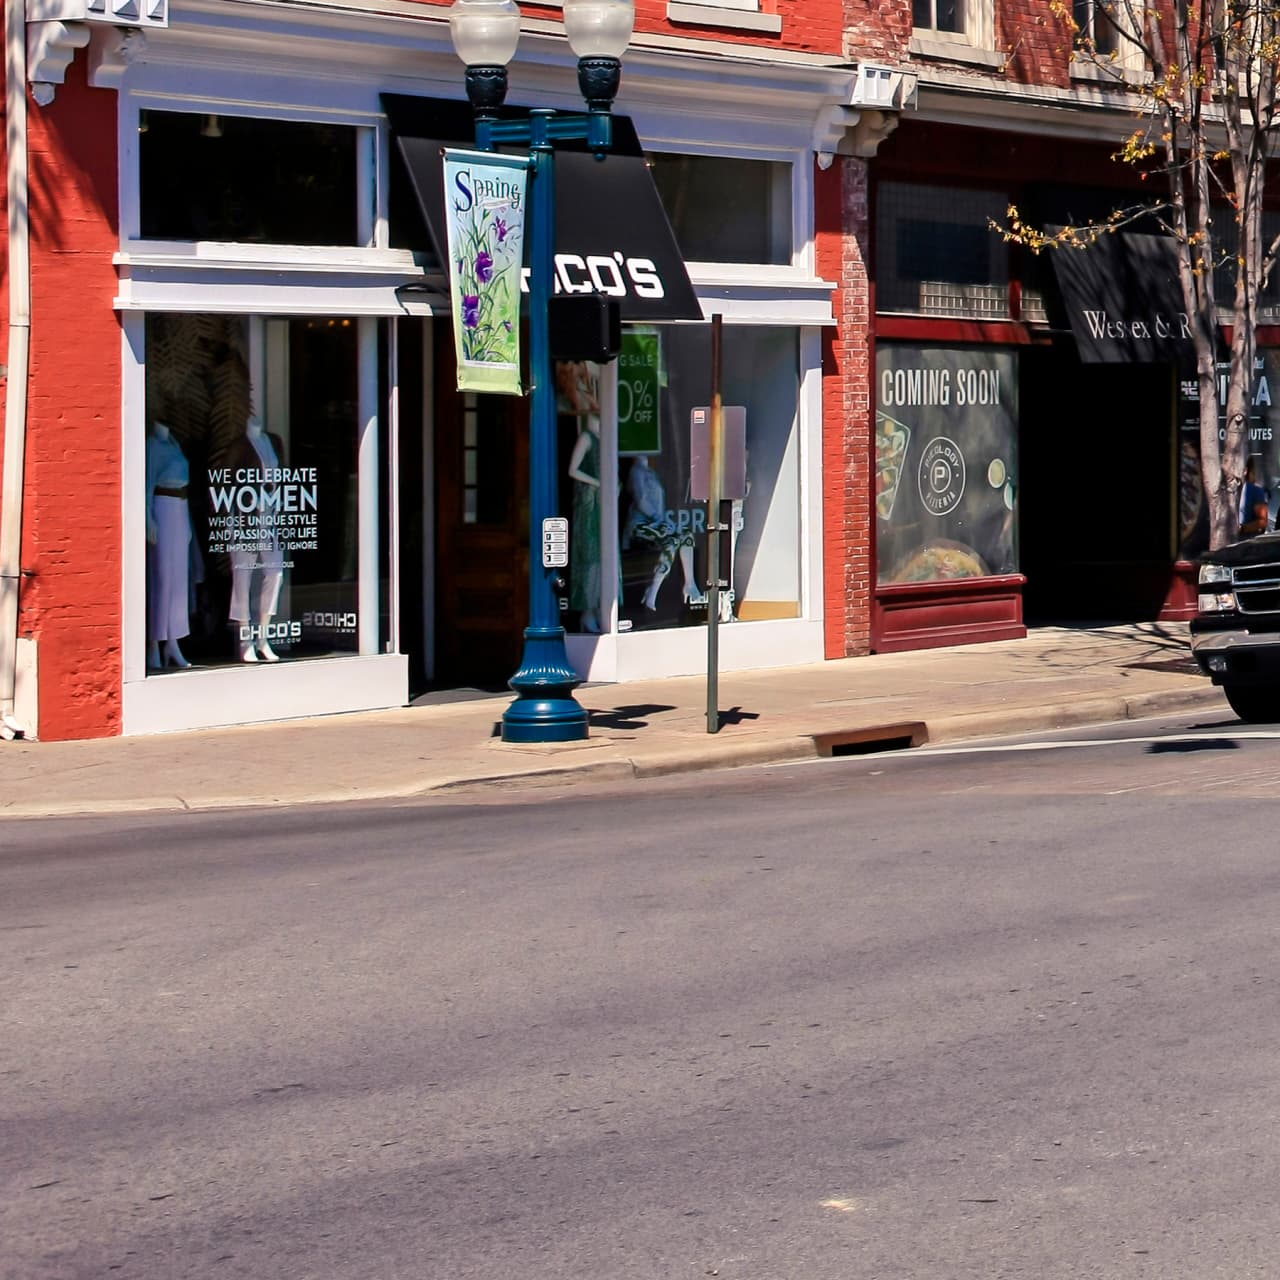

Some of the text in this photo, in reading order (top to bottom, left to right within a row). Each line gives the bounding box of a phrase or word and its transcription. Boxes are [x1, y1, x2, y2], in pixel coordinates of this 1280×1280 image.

[455, 170, 522, 212] Spring
[521, 251, 664, 298] CO'S
[1083, 310, 1151, 339] Wesex
[882, 369, 1000, 406] COMING SOON
[634, 410, 653, 423] OFF
[208, 468, 318, 484] WE CELEBRATE
[208, 485, 318, 513] WOMEN
[208, 514, 318, 527] WHOSE UNIQUE STYLE
[665, 509, 744, 536] SPR
[208, 527, 318, 541] AND PASSION FOR LIFE
[208, 543, 225, 553] ARE
[226, 542, 273, 552] IMPOSSIBLE
[287, 541, 318, 551] IGNORE
[240, 620, 302, 641] CHICO'S
